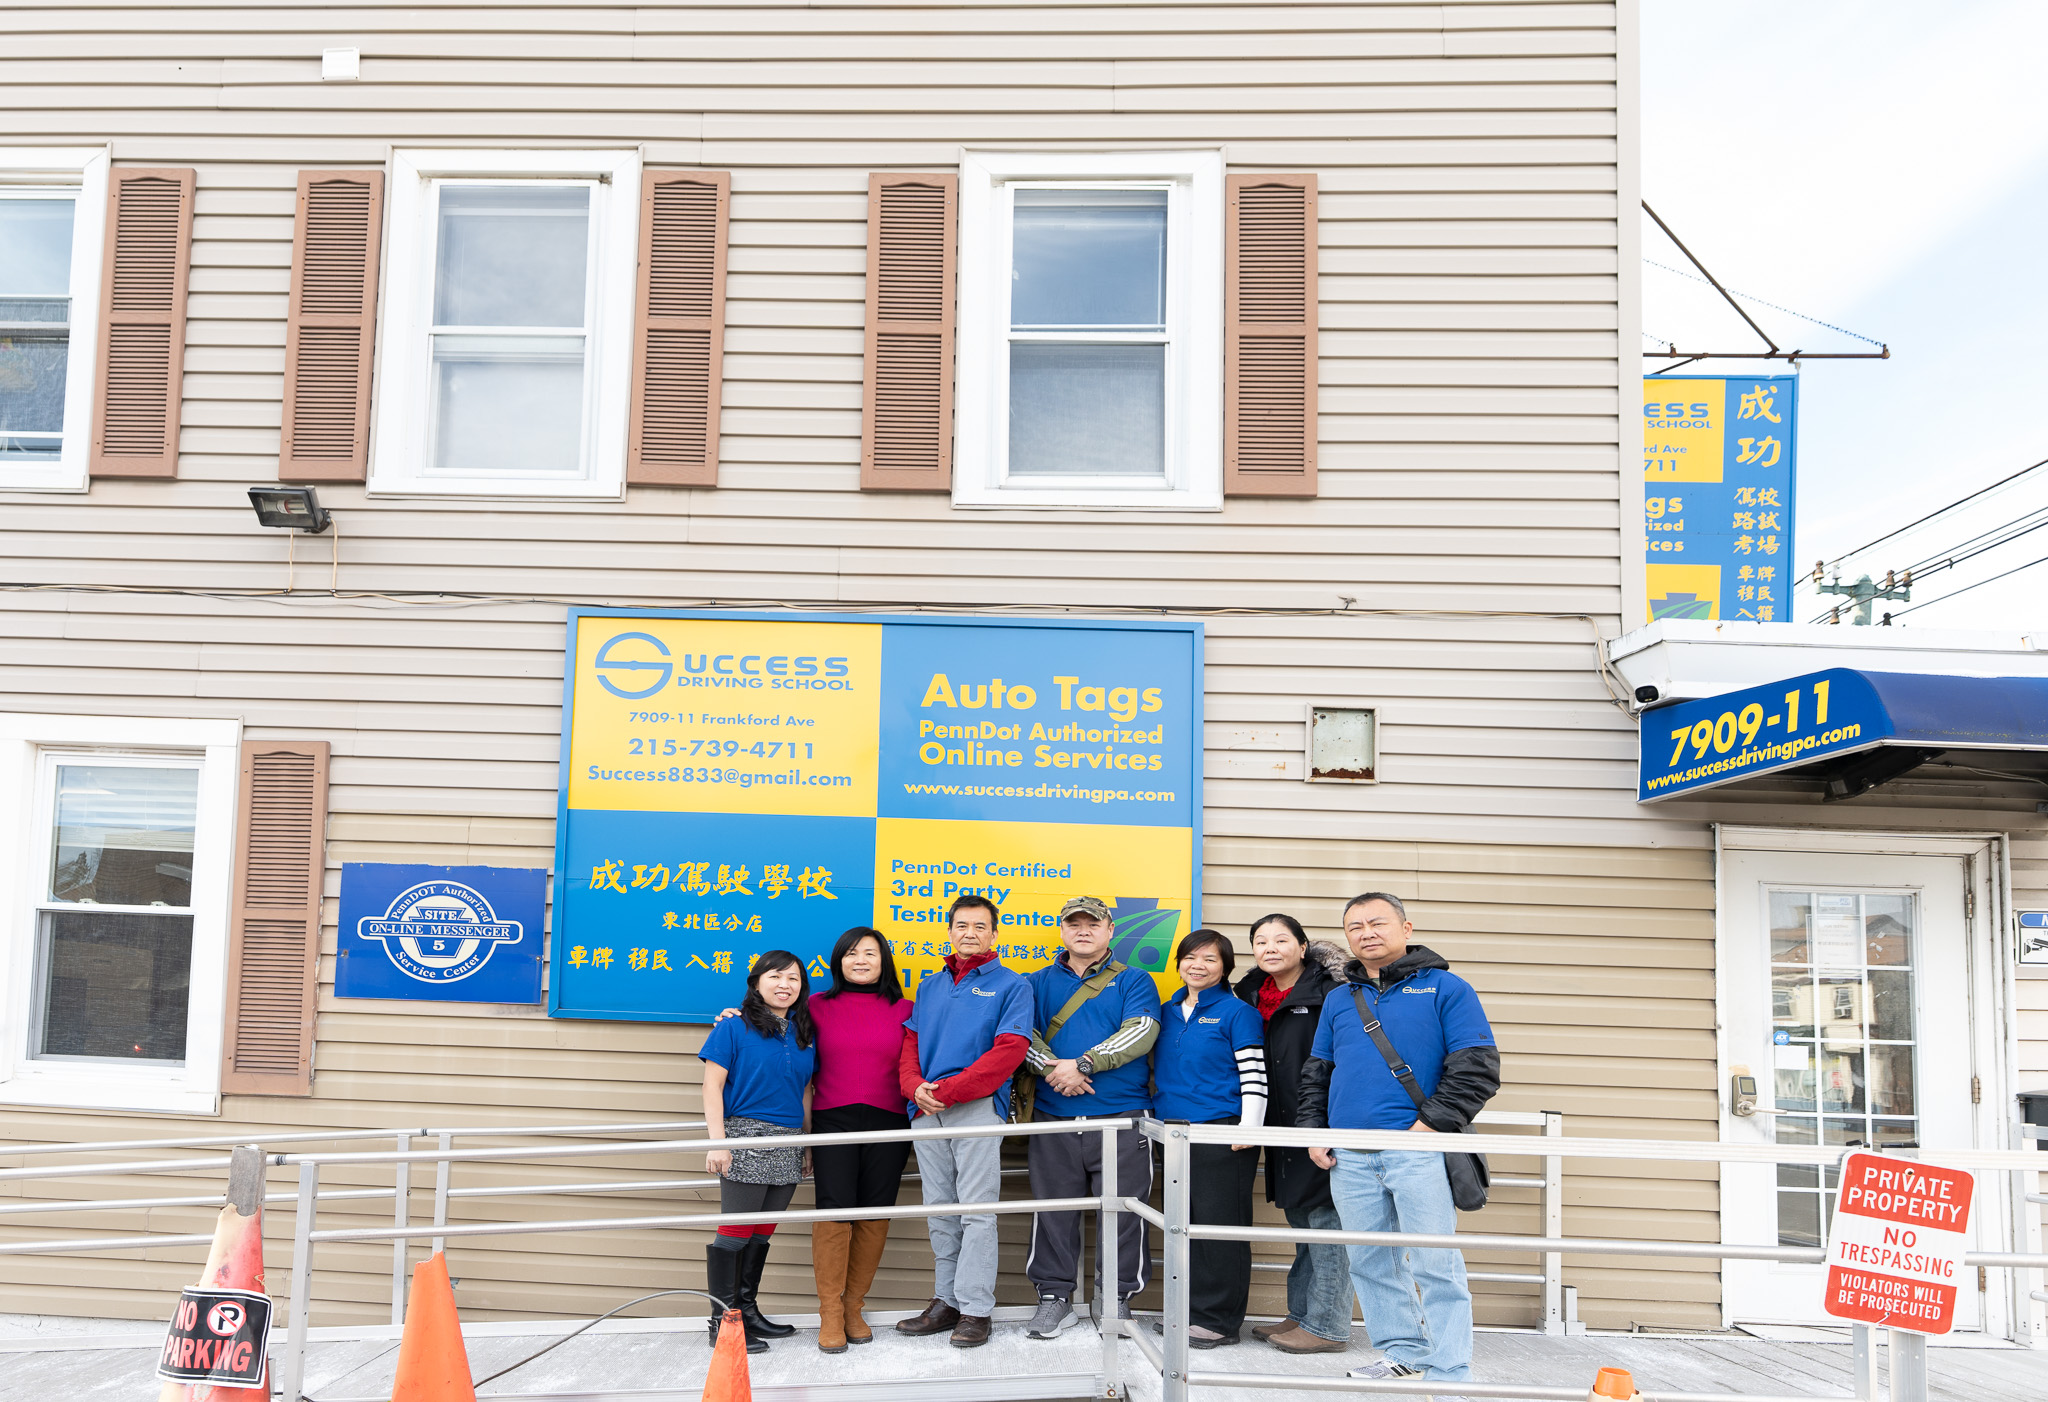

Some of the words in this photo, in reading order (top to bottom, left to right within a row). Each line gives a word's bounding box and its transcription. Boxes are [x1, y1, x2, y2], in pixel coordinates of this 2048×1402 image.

[1647, 420, 1713, 428] SCHOOL
[1736, 384, 1782, 468] 成功
[1662, 444, 1688, 453] Ave
[677, 676, 763, 689] DRIVING
[771, 678, 853, 691] SCHOOL
[920, 673, 1037, 710] Auto
[1053, 675, 1163, 722] Tags
[629, 711, 694, 724] 7909-11
[702, 713, 780, 727] Frankford
[786, 715, 815, 727] Ave
[1668, 679, 1830, 767] 7909-11
[919, 720, 1022, 740] PennDot
[1028, 721, 1163, 744] Authorized
[628, 738, 814, 760] 215-739-4711
[919, 741, 1023, 767] Online
[1034, 744, 1163, 771] Services
[1647, 723, 1861, 790] www.successdrivingpa.com
[588, 765, 852, 788] Success8833@gmail.com
[904, 783, 1175, 803] www.successdrivingpa.com
[891, 859, 978, 875] PennDot
[985, 862, 1072, 878] Certified
[891, 879, 933, 897] 3rd
[391, 885, 436, 920] PennDOT
[442, 885, 492, 923] Authorized
[424, 909, 459, 921] SITE
[889, 905, 950, 923] Testi
[996, 909, 1061, 927] enter
[369, 923, 424, 935] ON-LINE
[430, 925, 511, 937] MESSENGER
[662, 911, 762, 932] 東北區分店
[433, 940, 445, 951] 5
[395, 951, 436, 979] Service
[443, 953, 480, 978] Center
[567, 945, 614, 970] 車牌
[628, 947, 672, 972] 移民
[685, 950, 734, 974] 入籍
[1863, 1166, 1954, 1200] PRIVATE
[1847, 1186, 1962, 1223] PROPERTY
[1883, 1226, 1917, 1248] NO
[1840, 1241, 1954, 1278] TRESPASSING
[1840, 1272, 1910, 1298] VIOLATORS
[1914, 1286, 1944, 1304] WILL
[175, 1299, 198, 1331] NO
[1838, 1289, 1854, 1305] BE
[1859, 1293, 1941, 1320] PROSECUTED
[163, 1334, 253, 1372] PARKING
